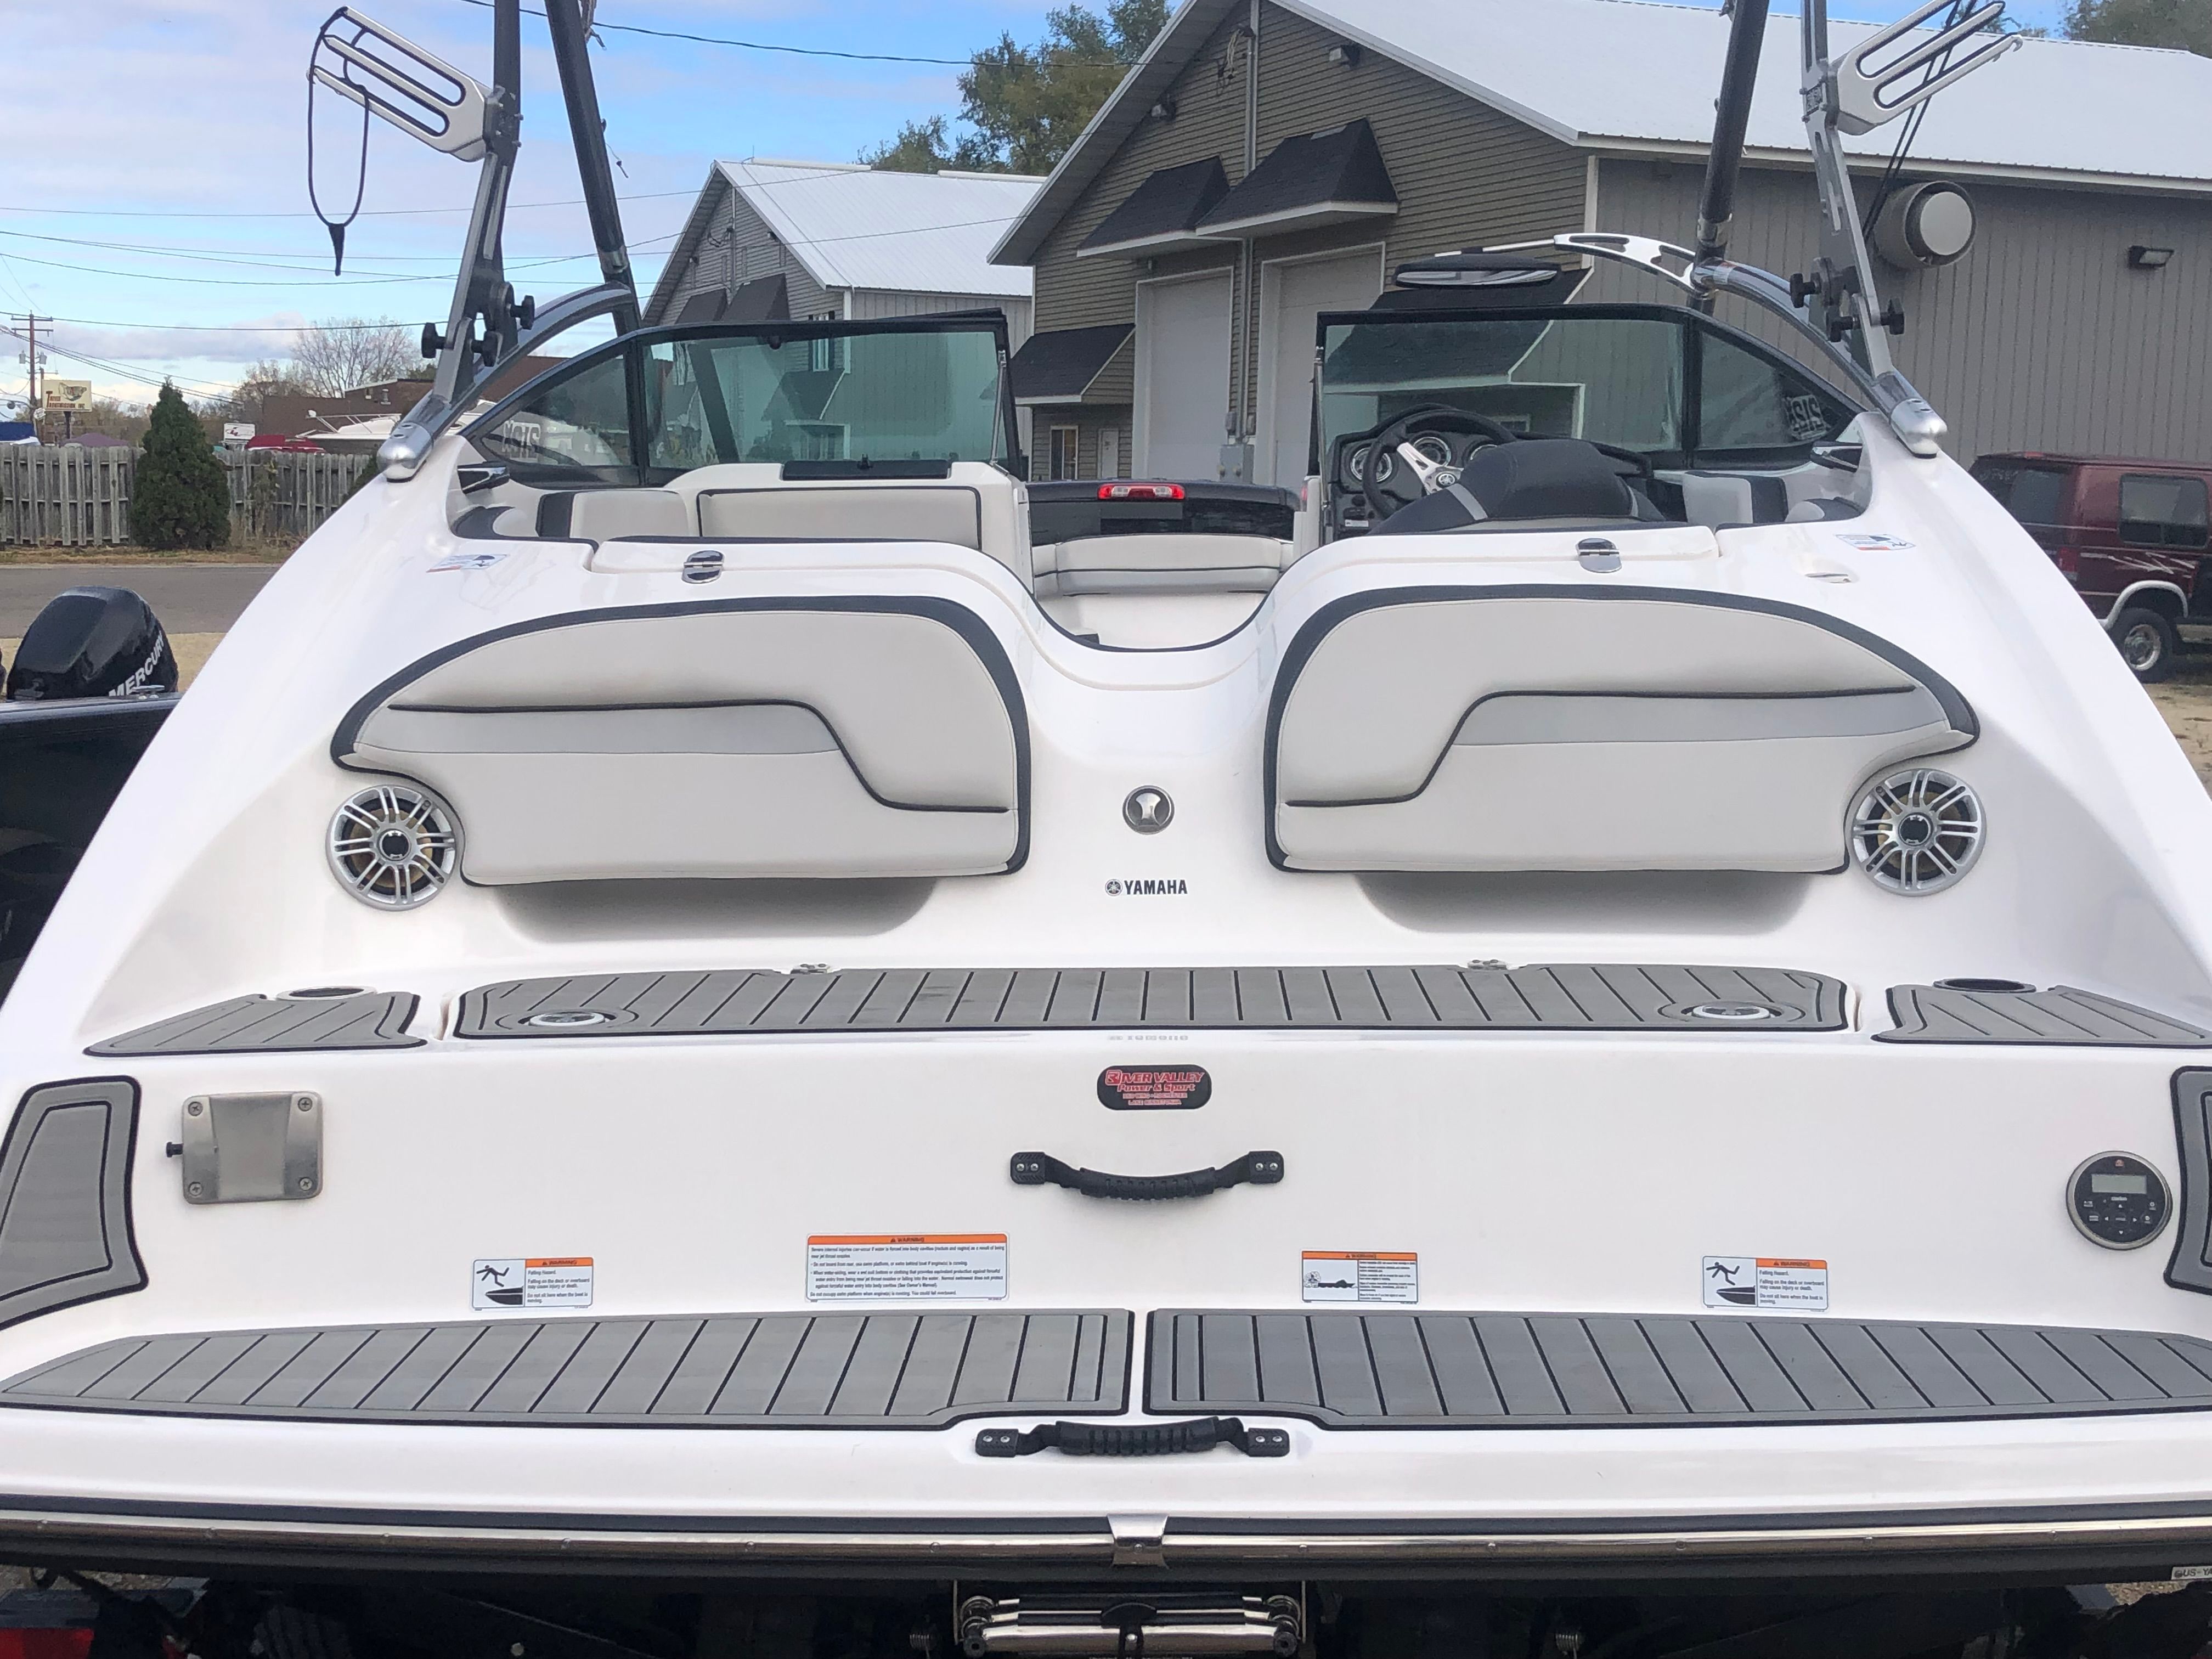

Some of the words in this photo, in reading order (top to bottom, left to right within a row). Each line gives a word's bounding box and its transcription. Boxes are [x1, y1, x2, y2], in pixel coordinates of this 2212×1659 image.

[109, 630, 164, 696] MERCURY
[1124, 879, 1188, 895] YAMAHA
[1105, 1070, 1152, 1086] RIVER
[1154, 1071, 1205, 1083] VALLEY
[1117, 1084, 1152, 1092] Power
[1153, 1084, 1162, 1092] &
[1164, 1084, 1195, 1093] Sport
